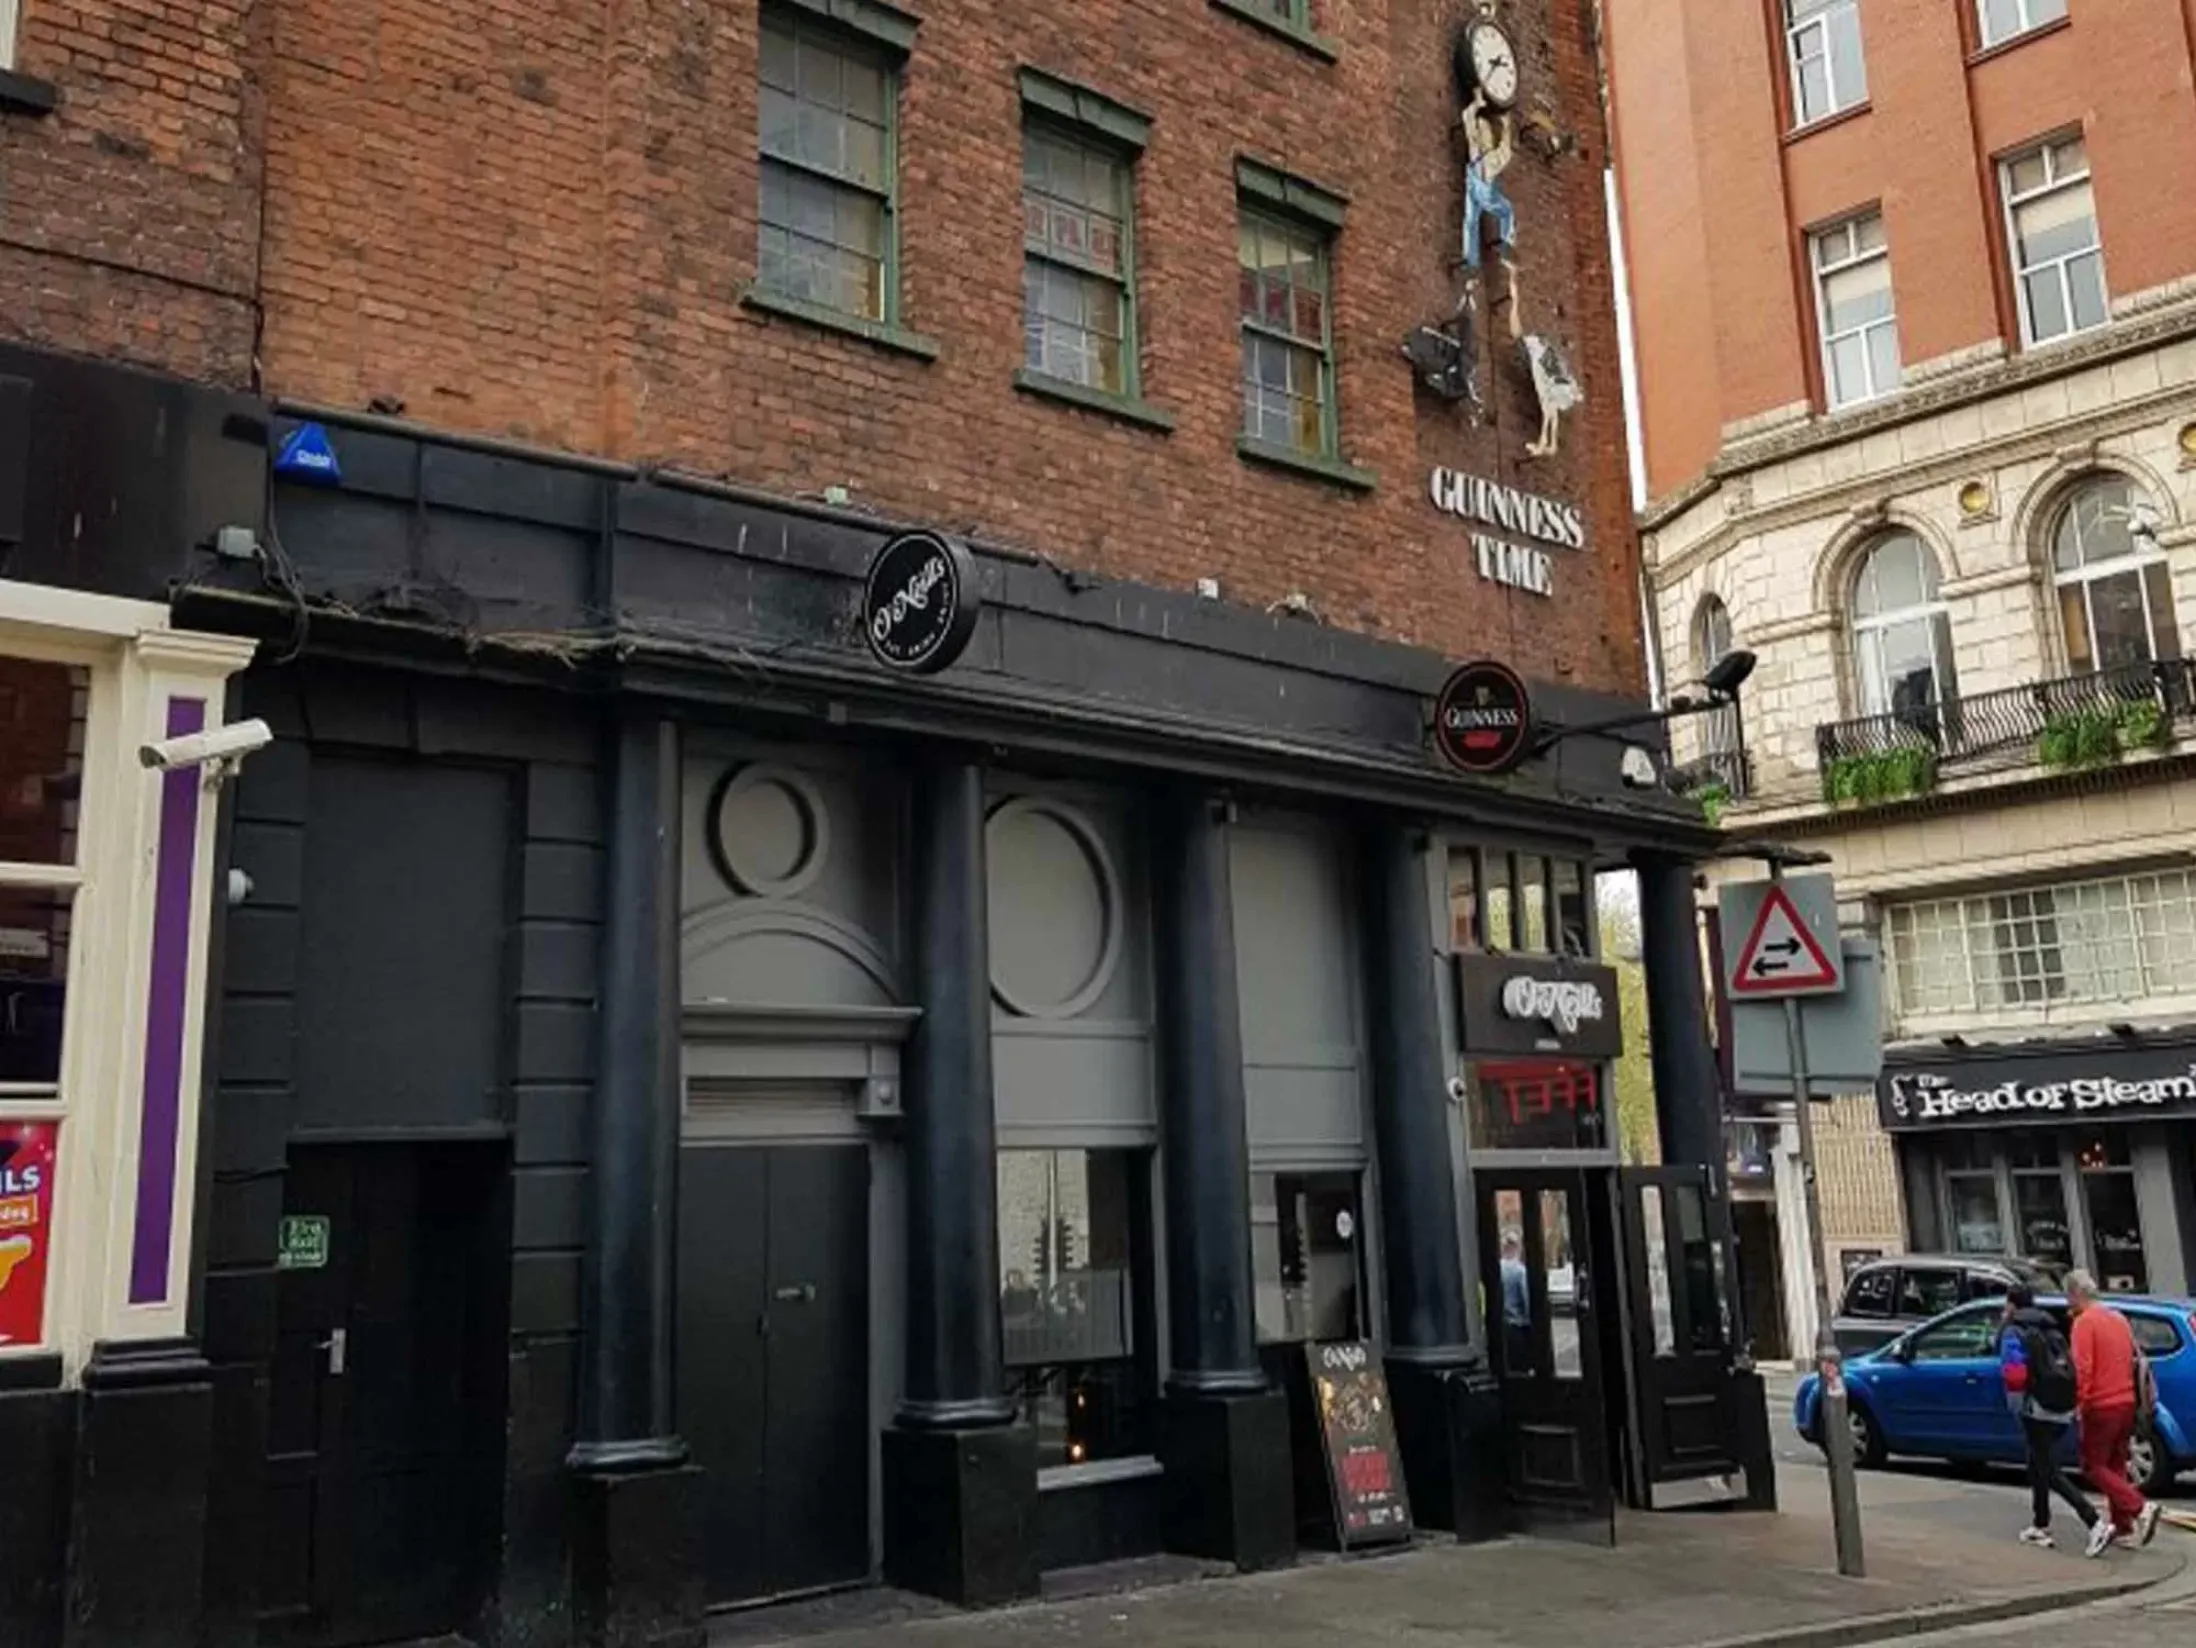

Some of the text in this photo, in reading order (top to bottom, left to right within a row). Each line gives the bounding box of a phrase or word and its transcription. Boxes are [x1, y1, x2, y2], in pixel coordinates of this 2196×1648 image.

[1430, 465, 1584, 549] GUINNESS
[1470, 531, 1553, 597] TIME
[1915, 1080, 2026, 1117] Head
[2070, 1077, 2196, 1110] Steam
